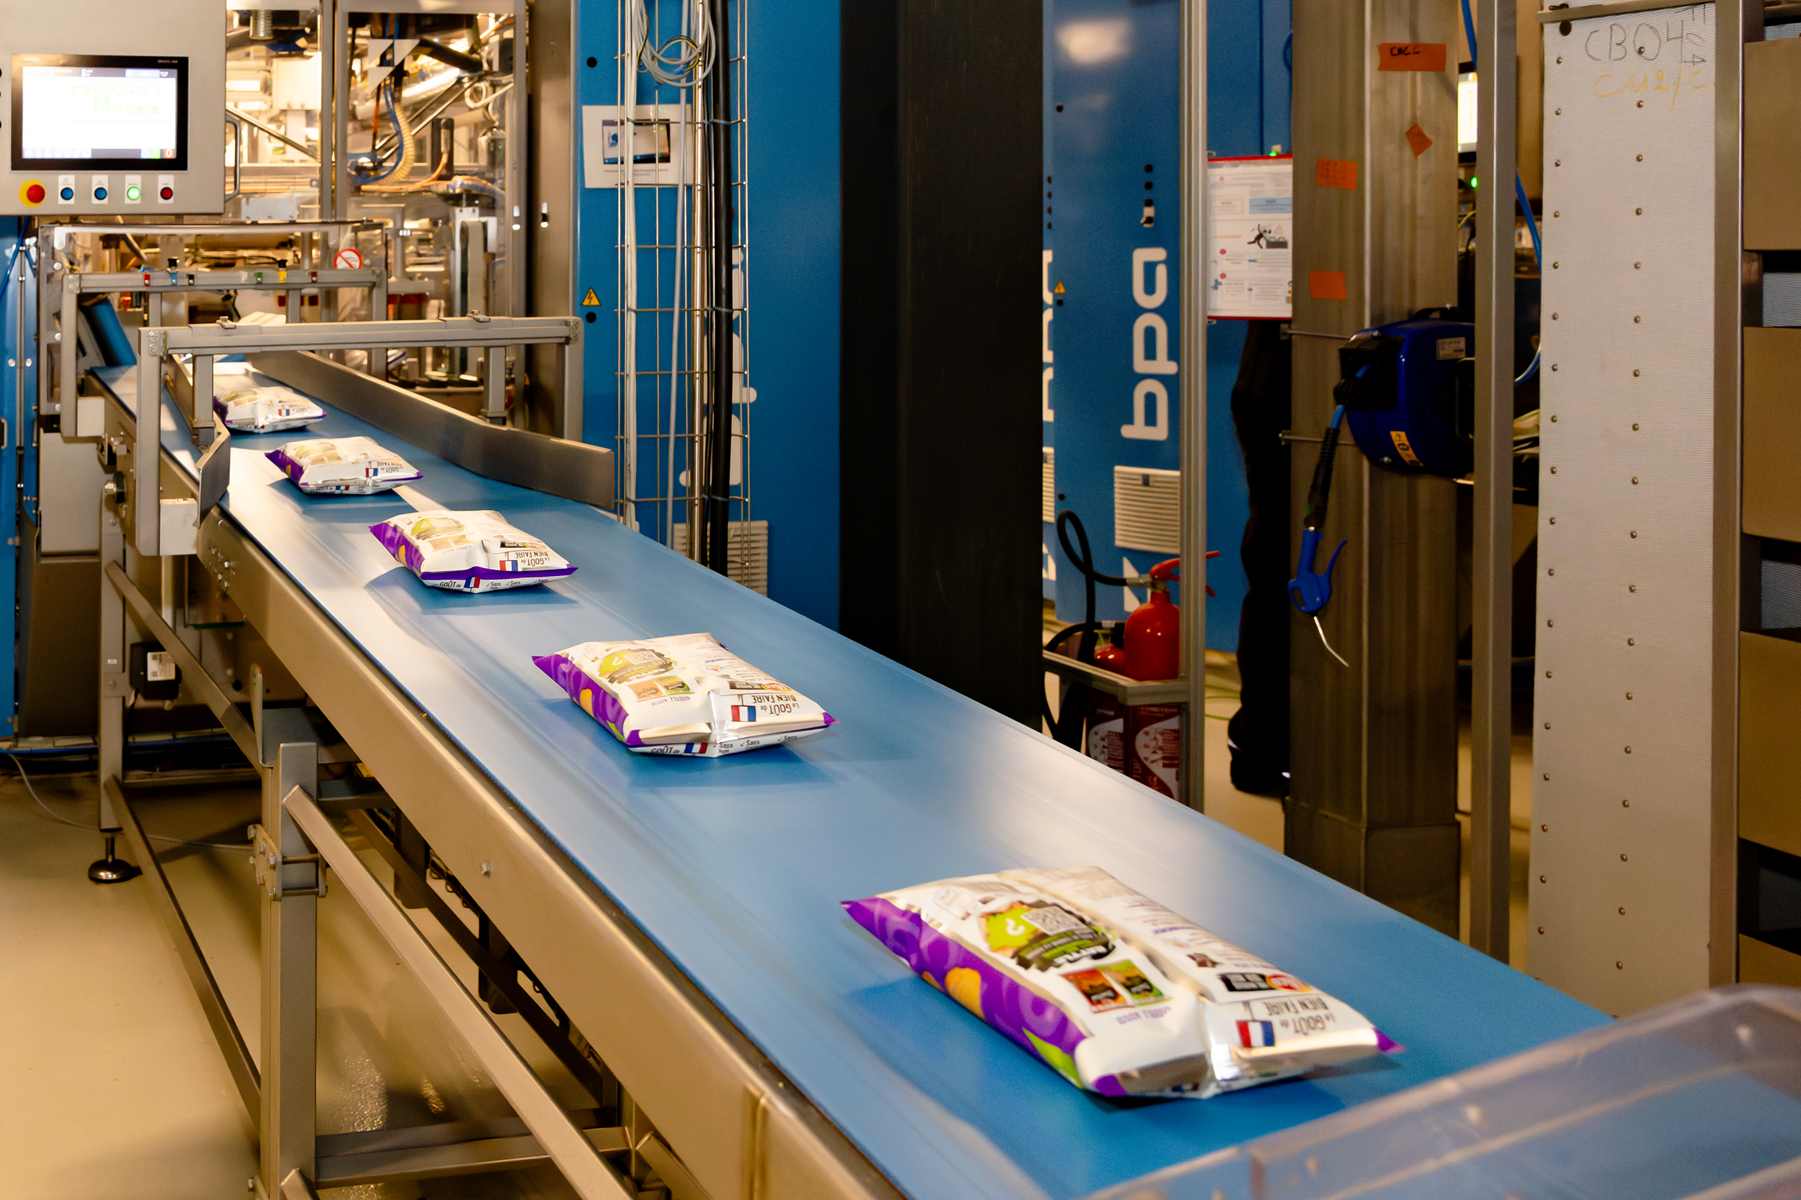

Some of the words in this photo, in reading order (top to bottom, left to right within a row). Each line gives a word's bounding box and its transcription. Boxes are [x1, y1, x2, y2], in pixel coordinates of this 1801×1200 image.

[1120, 246, 1178, 441] bpa
[752, 695, 776, 704] FAIRE
[768, 703, 792, 716] GOÛT
[1262, 1000, 1298, 1016] FAIRE
[1290, 1014, 1326, 1036] GOÛT
